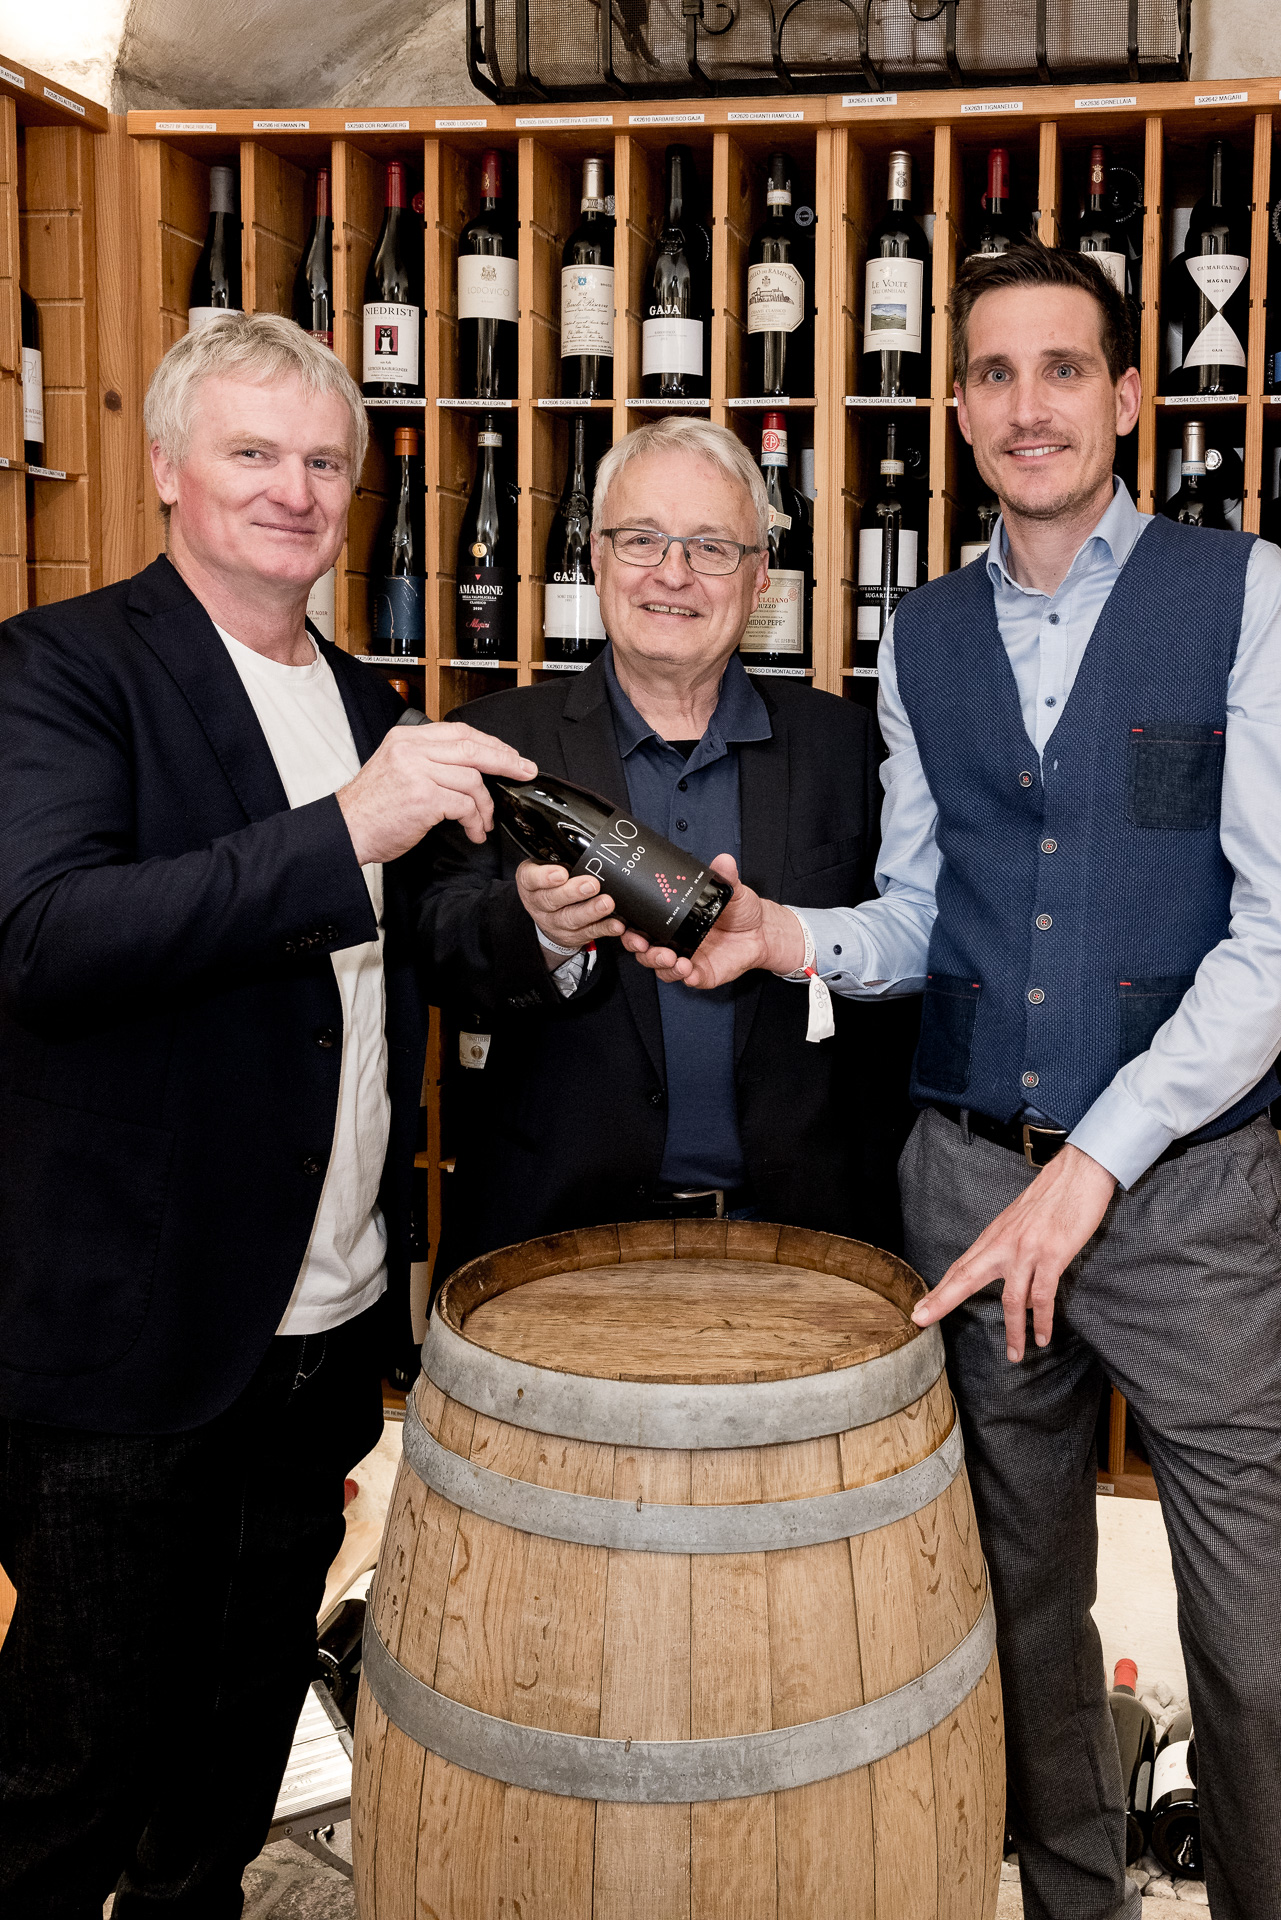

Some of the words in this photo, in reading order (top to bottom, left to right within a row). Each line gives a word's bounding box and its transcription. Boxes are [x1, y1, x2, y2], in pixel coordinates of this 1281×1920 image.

[1218, 94, 1242, 102] MAGARI
[467, 286, 510, 297] LODOVICO
[365, 306, 414, 317] NIEDRIST
[649, 304, 682, 316] GAJA
[553, 571, 587, 582] GAJA
[458, 584, 504, 596] AMARONE
[772, 668, 805, 676] MONTALCINO
[585, 820, 638, 882] PINO
[621, 846, 646, 876] 3000
